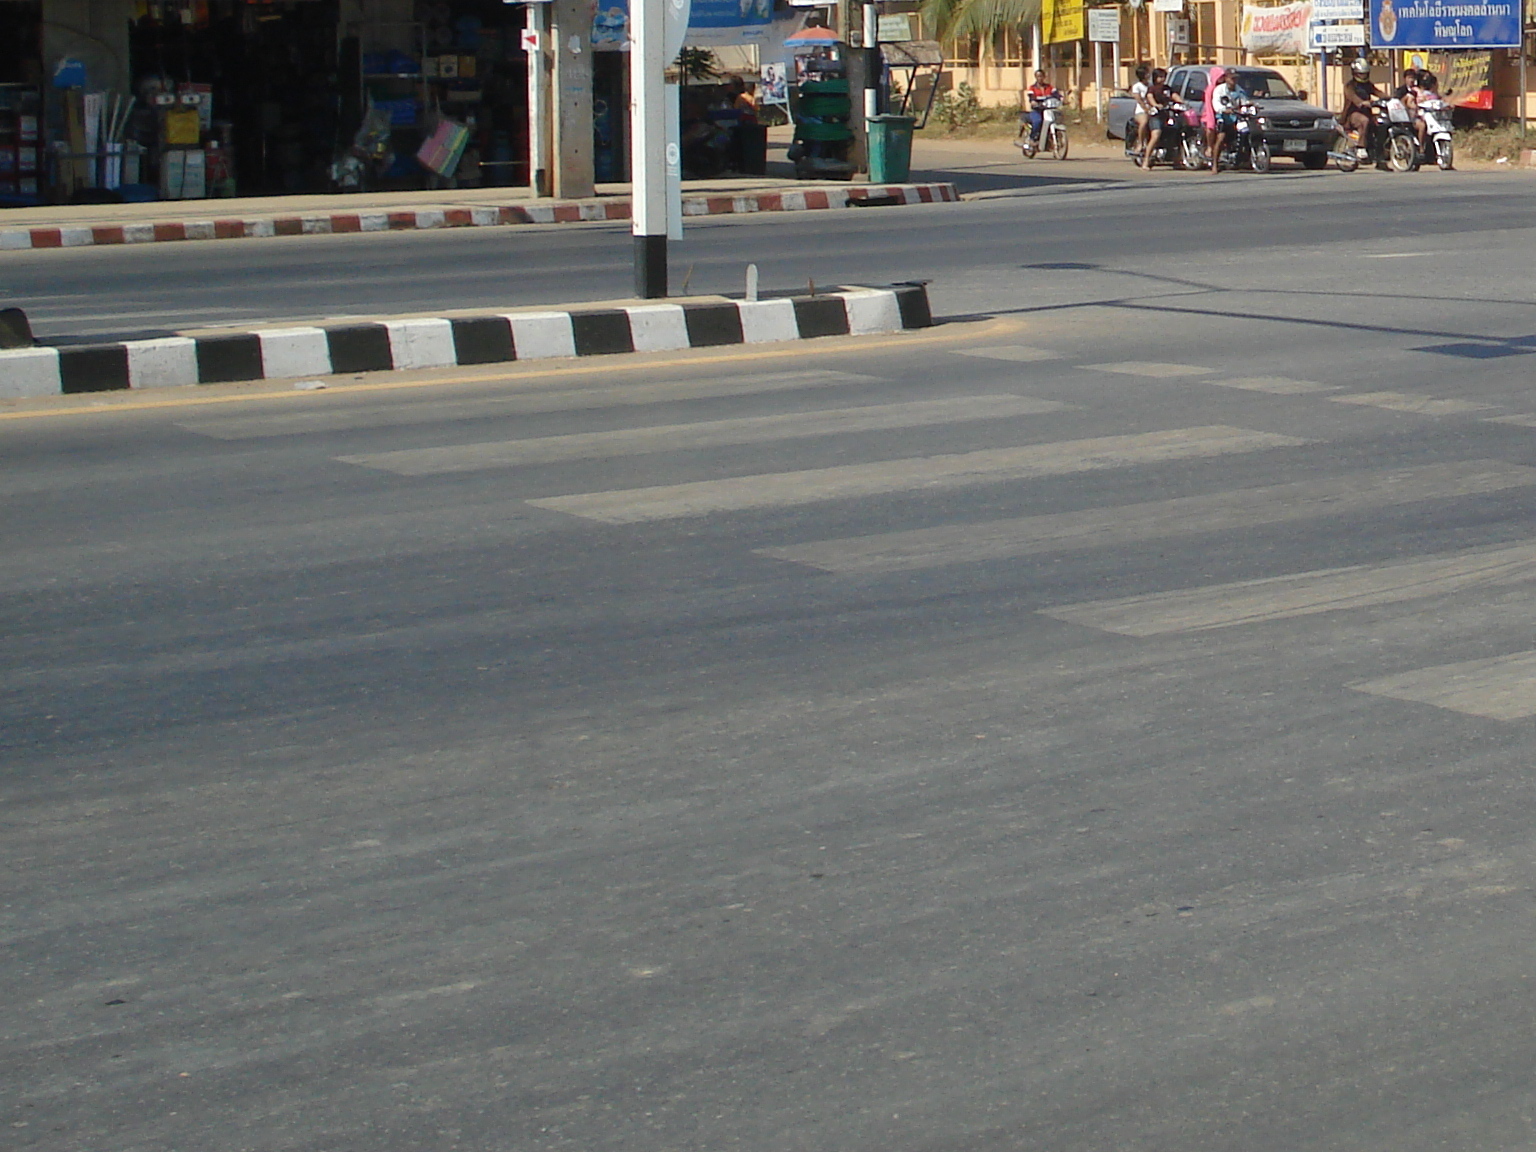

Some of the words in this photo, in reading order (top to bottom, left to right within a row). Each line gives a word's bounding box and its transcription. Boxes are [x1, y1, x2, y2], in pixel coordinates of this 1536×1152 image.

[1398, 0, 1511, 18] เทคโนโลยีราชมงคลล้านนา
[1434, 19, 1473, 42] พิษณุโลก
